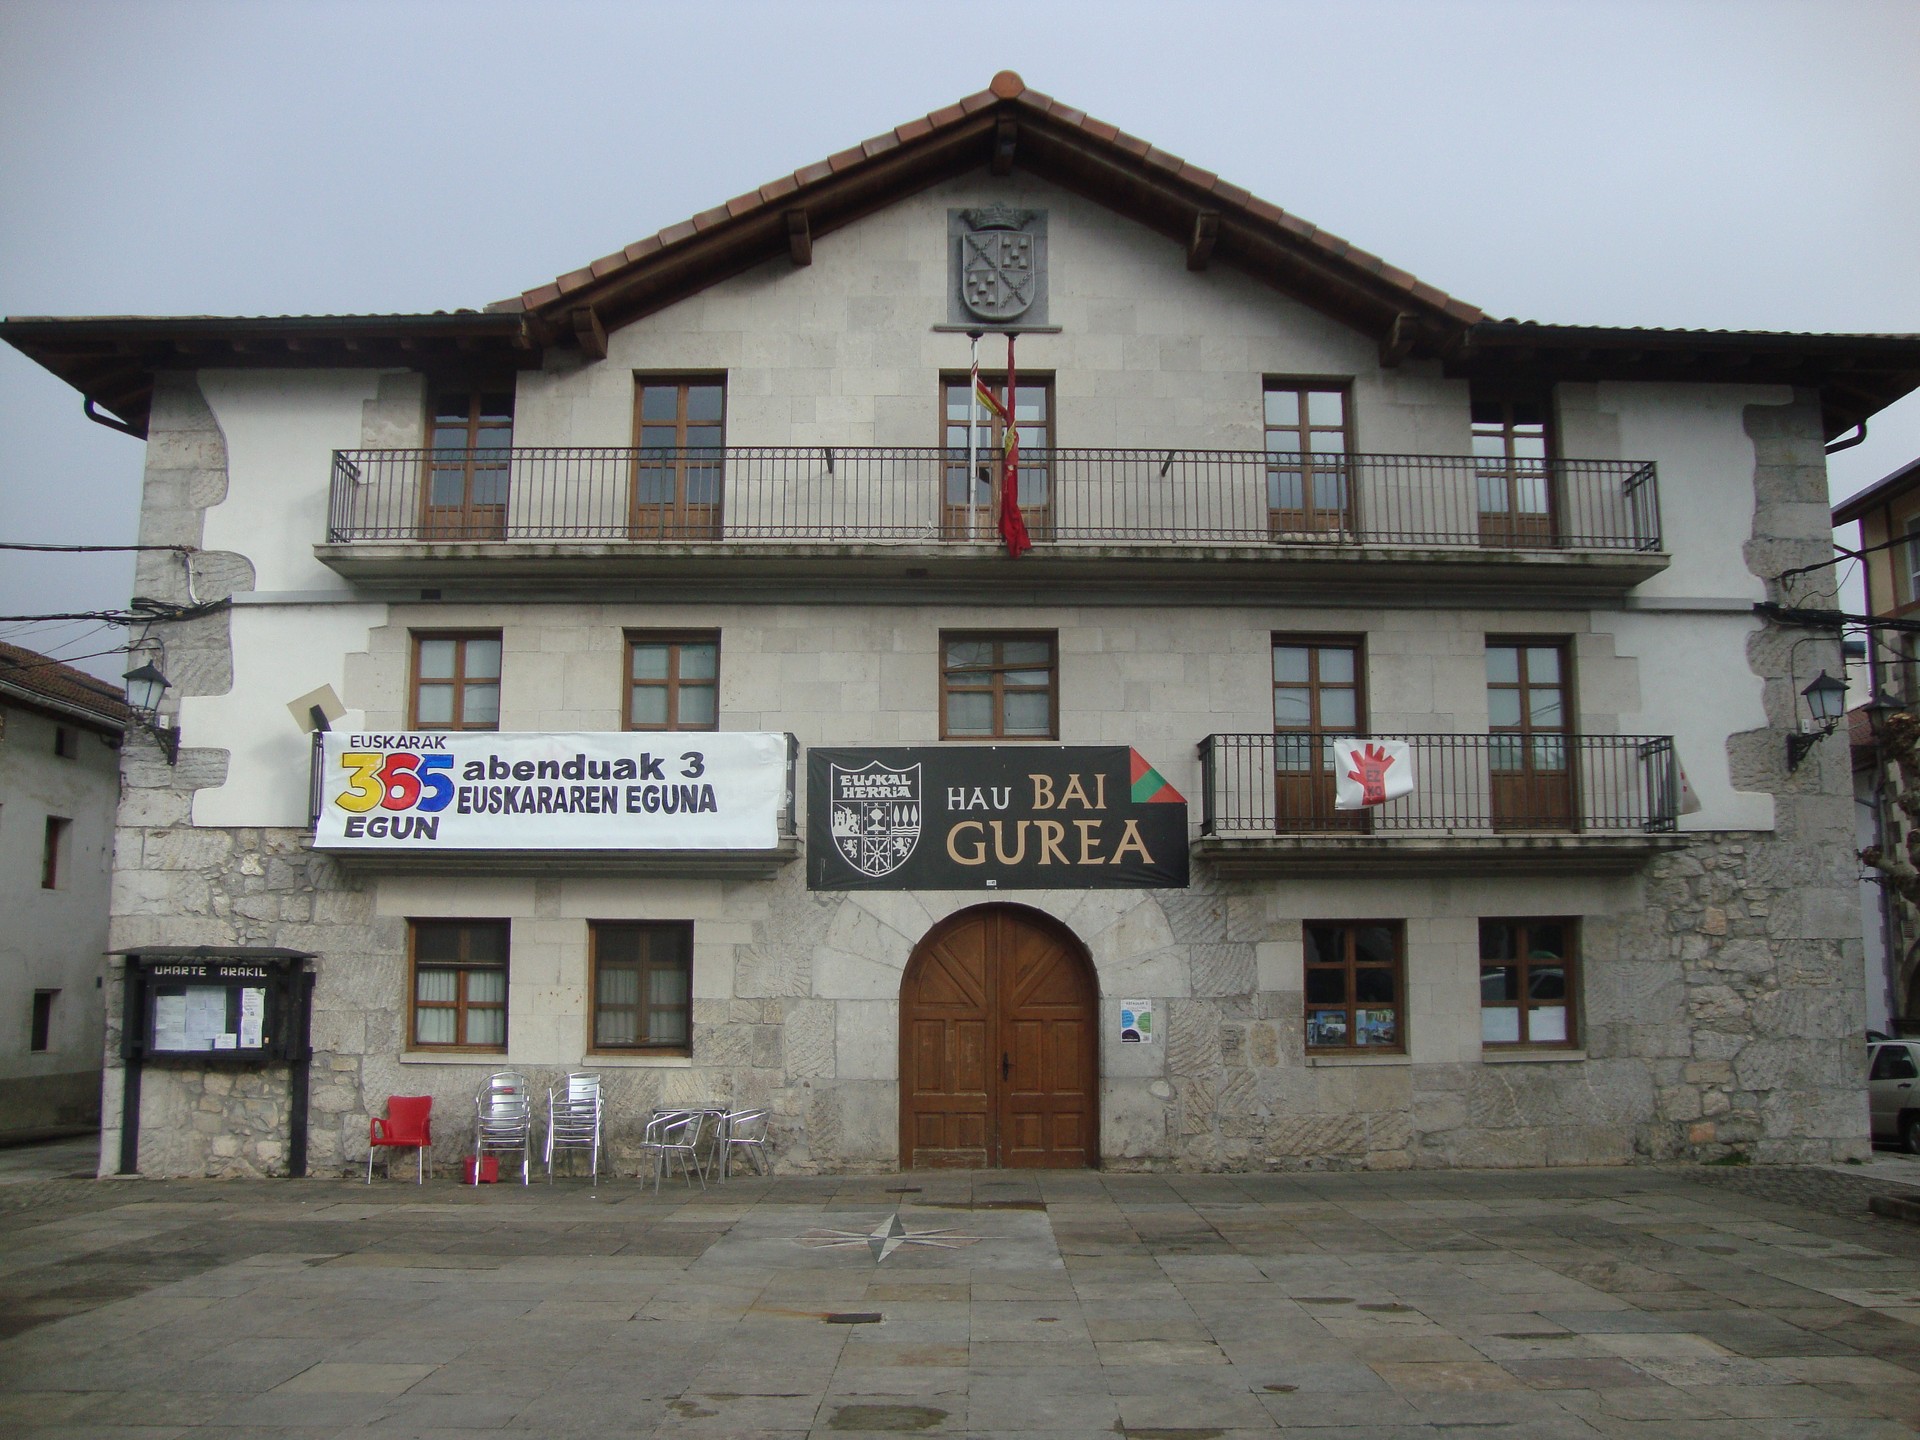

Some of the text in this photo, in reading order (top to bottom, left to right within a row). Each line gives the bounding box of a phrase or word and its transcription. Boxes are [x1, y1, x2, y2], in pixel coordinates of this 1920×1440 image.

[350, 735, 447, 750] EUSKARAK
[462, 751, 705, 781] abenduak 3
[840, 774, 912, 786] EUSKAL
[335, 752, 455, 813] 365
[947, 773, 1106, 811] HAU BAI
[457, 784, 718, 815] EUSKARAREN EGUNA
[344, 816, 440, 840] EGUN
[946, 819, 1156, 866] GUREA
[154, 966, 268, 977] UHARTE ARAKIL
